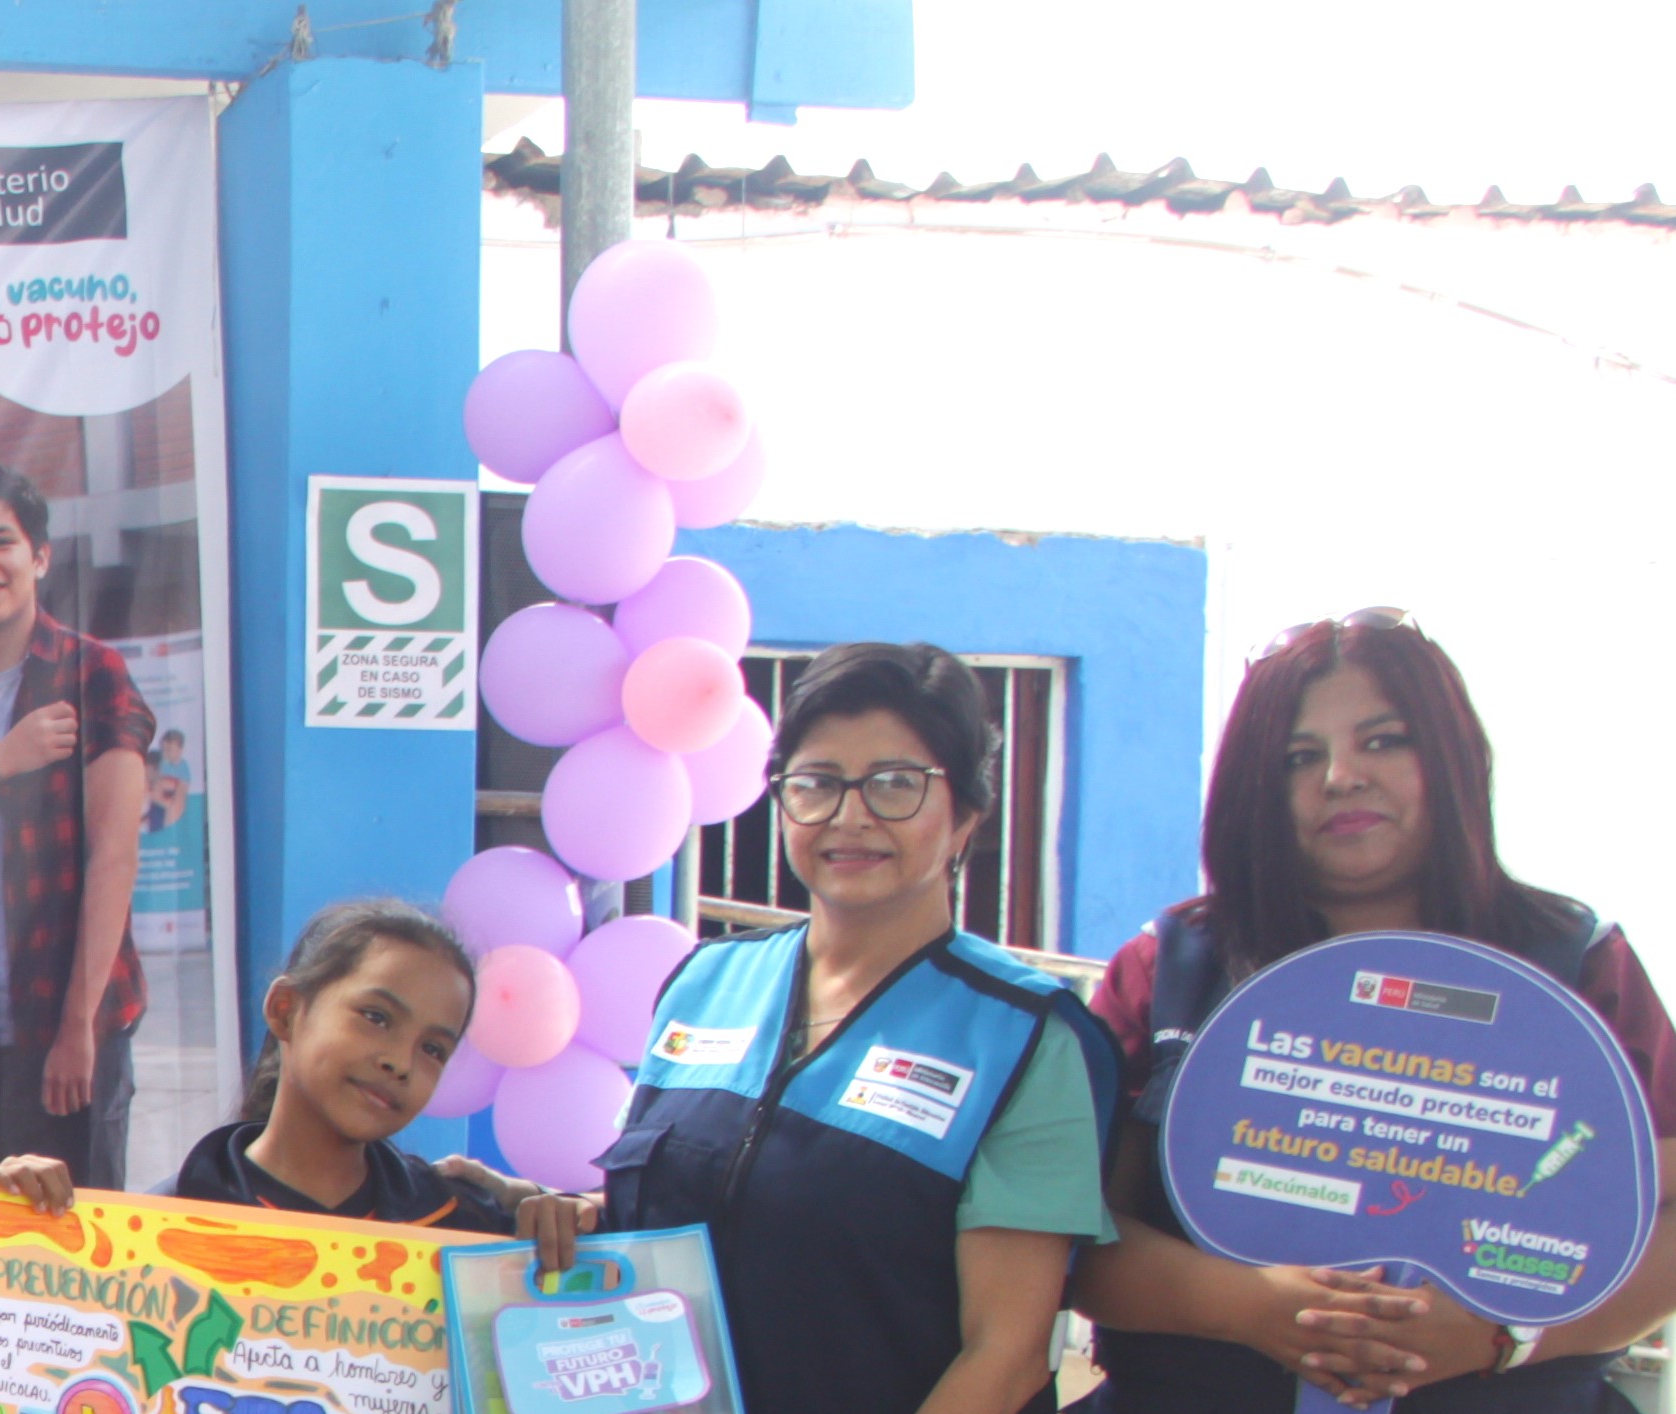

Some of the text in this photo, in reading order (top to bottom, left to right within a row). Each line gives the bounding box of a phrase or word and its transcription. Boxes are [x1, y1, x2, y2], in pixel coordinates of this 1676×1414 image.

[23, 305, 160, 357] protejo
[342, 501, 441, 625] S
[342, 653, 438, 667] ZONA SEGURA
[360, 671, 420, 683] EN CASO
[358, 687, 422, 699] DE SISMO
[1248, 1019, 1560, 1099] Las vacunas son el
[1253, 1063, 1542, 1132] mejor escudo protector
[1298, 1106, 1471, 1153] para tener un
[1232, 1118, 1526, 1199] futuro saludable.
[1235, 1165, 1351, 1206] #Vacúnalos
[232, 1341, 448, 1401] Afecta a hombres y
[555, 1347, 624, 1372] FUTURO
[556, 1361, 638, 1399] VPH
